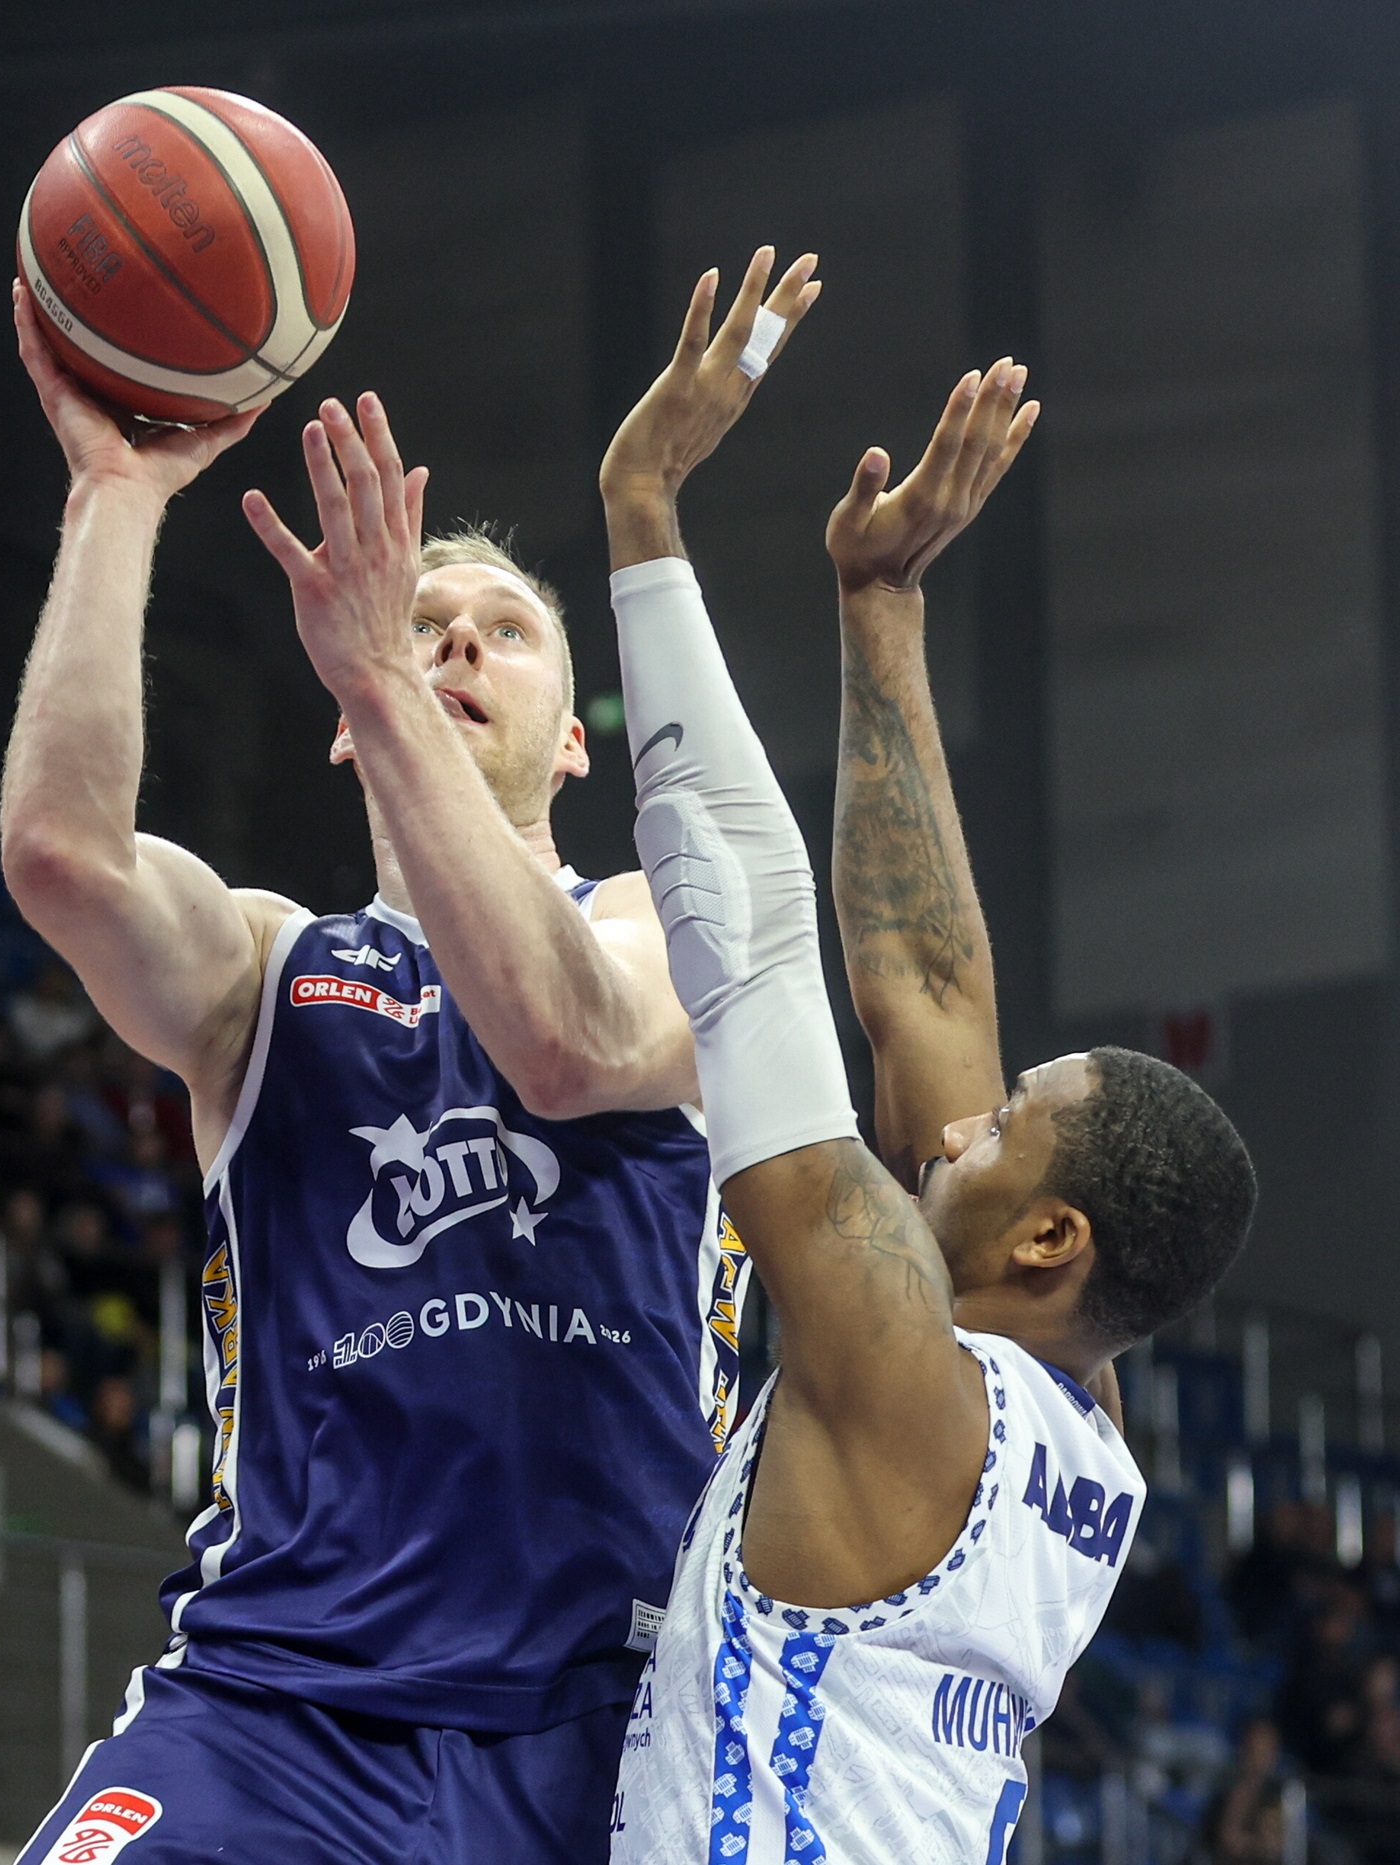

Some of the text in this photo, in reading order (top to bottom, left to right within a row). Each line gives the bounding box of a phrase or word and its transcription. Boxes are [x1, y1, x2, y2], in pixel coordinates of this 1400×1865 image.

[112, 135, 215, 253] molten
[58, 238, 100, 294] APPROVED
[67, 213, 123, 282] FIBA
[298, 981, 372, 1003] ORLEN
[202, 1240, 239, 1389] ARKA
[307, 1350, 327, 1371] 196
[419, 1291, 597, 1344] GDYNIA
[600, 1323, 631, 1344] 2026
[1023, 1442, 1134, 1568] ALBA
[90, 1802, 148, 1824] ORLEN
